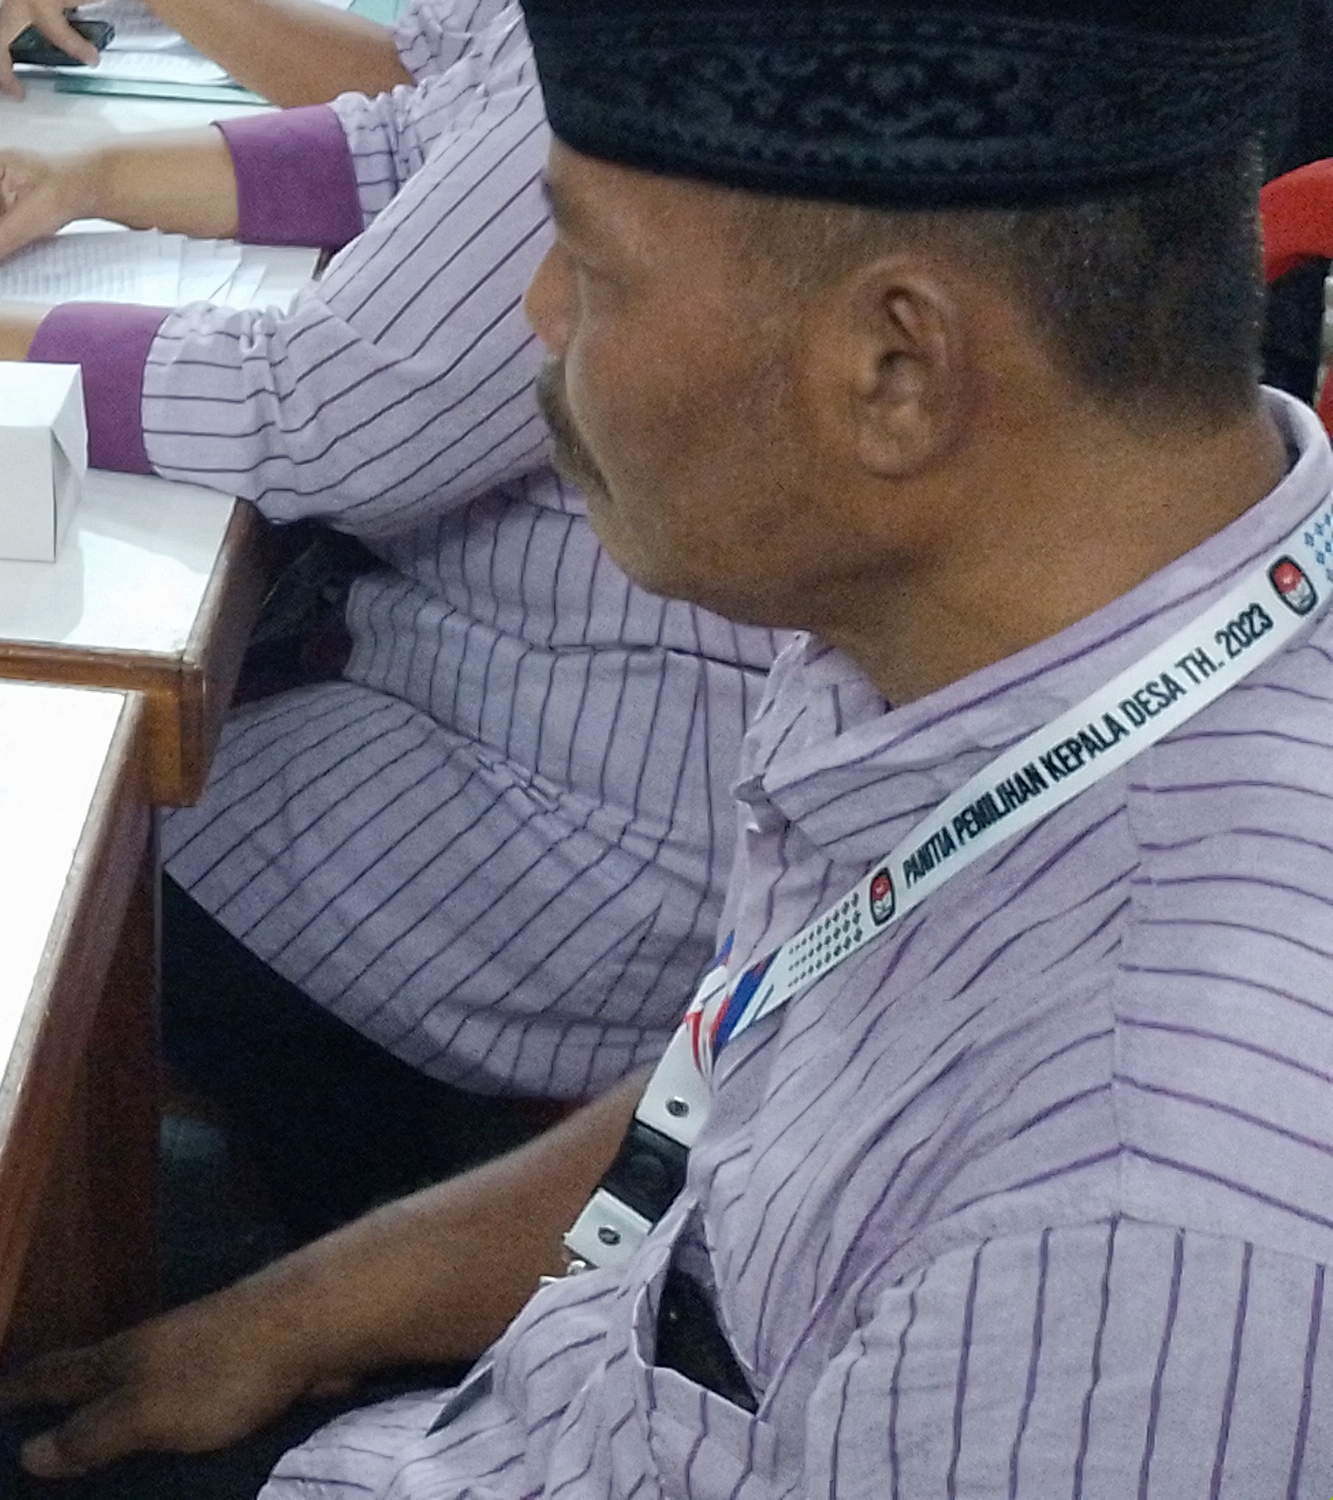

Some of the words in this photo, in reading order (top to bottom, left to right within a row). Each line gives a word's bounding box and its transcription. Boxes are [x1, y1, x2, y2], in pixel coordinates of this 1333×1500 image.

[902, 826, 956, 888] PANITIA
[951, 762, 1048, 844] PEMILIHAN
[1038, 712, 1129, 782] KEPALA
[1117, 673, 1187, 730] DESA
[1174, 646, 1225, 685] TH.
[1215, 602, 1274, 659] 2023
